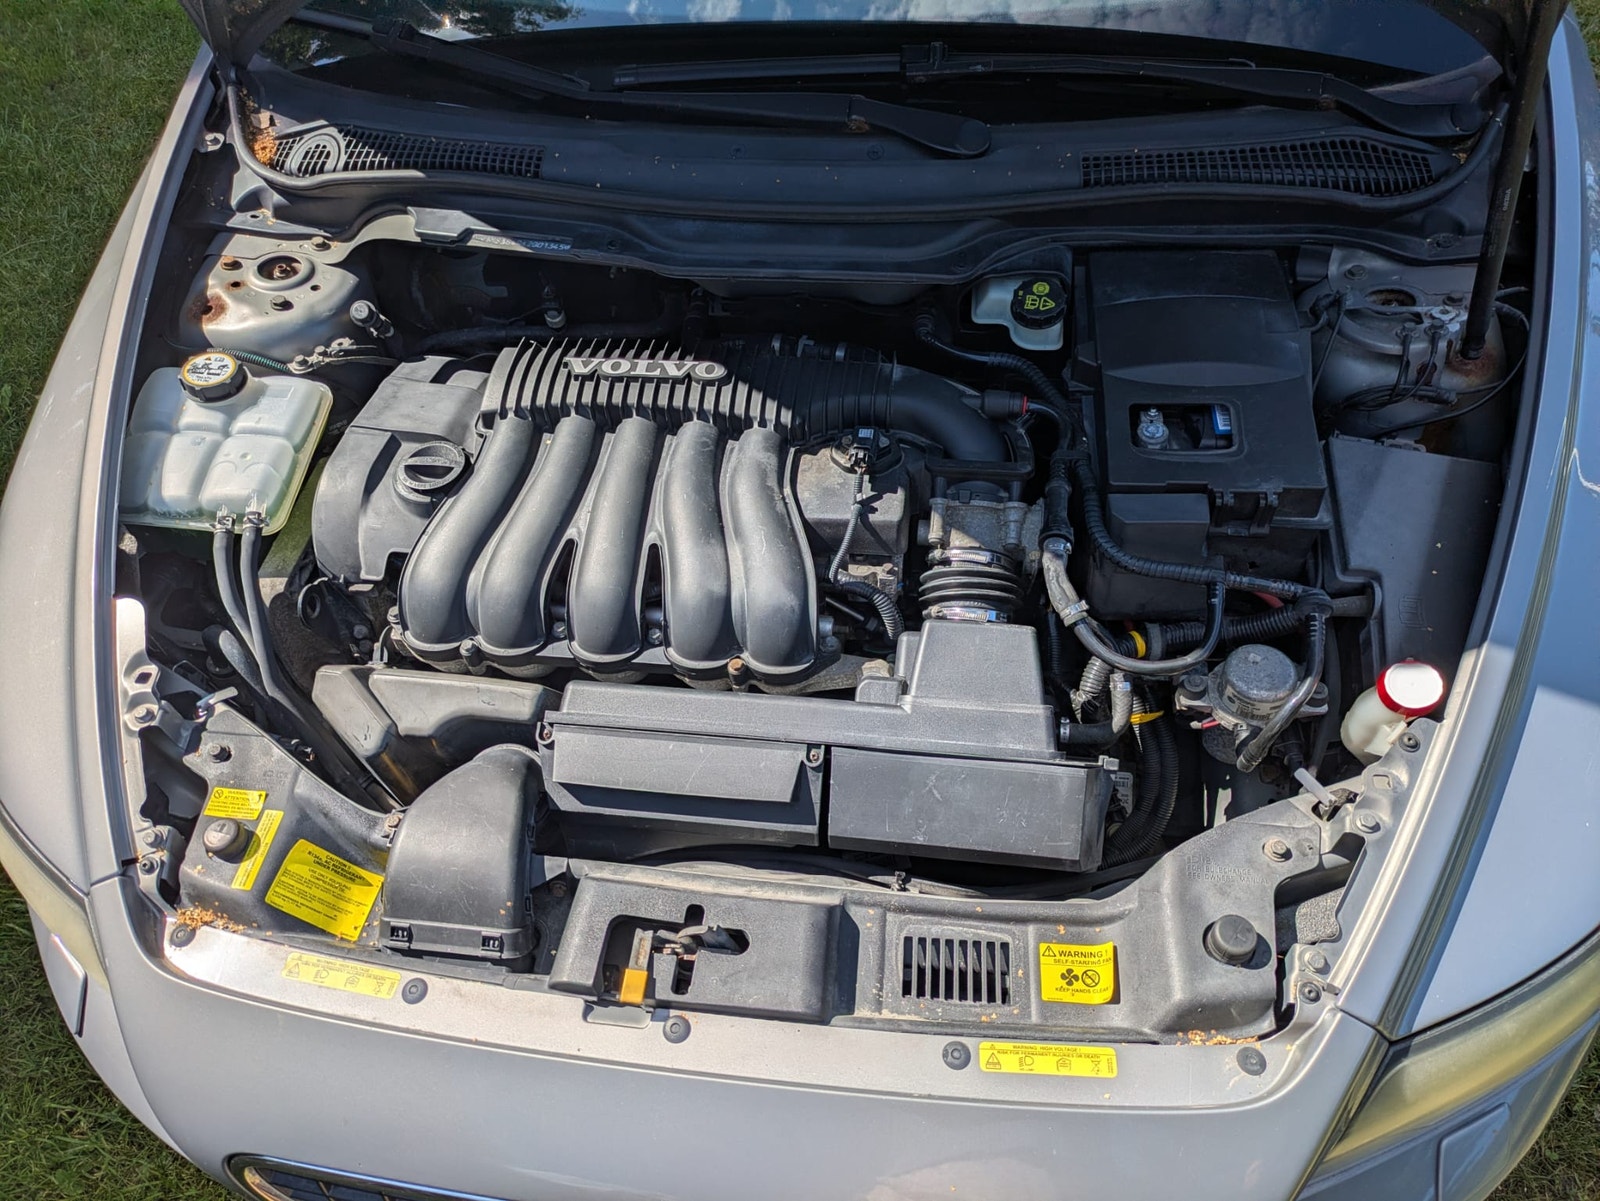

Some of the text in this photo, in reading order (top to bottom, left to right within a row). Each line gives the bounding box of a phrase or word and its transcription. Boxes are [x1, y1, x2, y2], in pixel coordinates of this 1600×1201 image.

[565, 357, 726, 378] VOLVO
[325, 854, 347, 868] CAUTION
[1058, 950, 1103, 958] WARNING
[1053, 958, 1102, 966] SELF-STARTING
